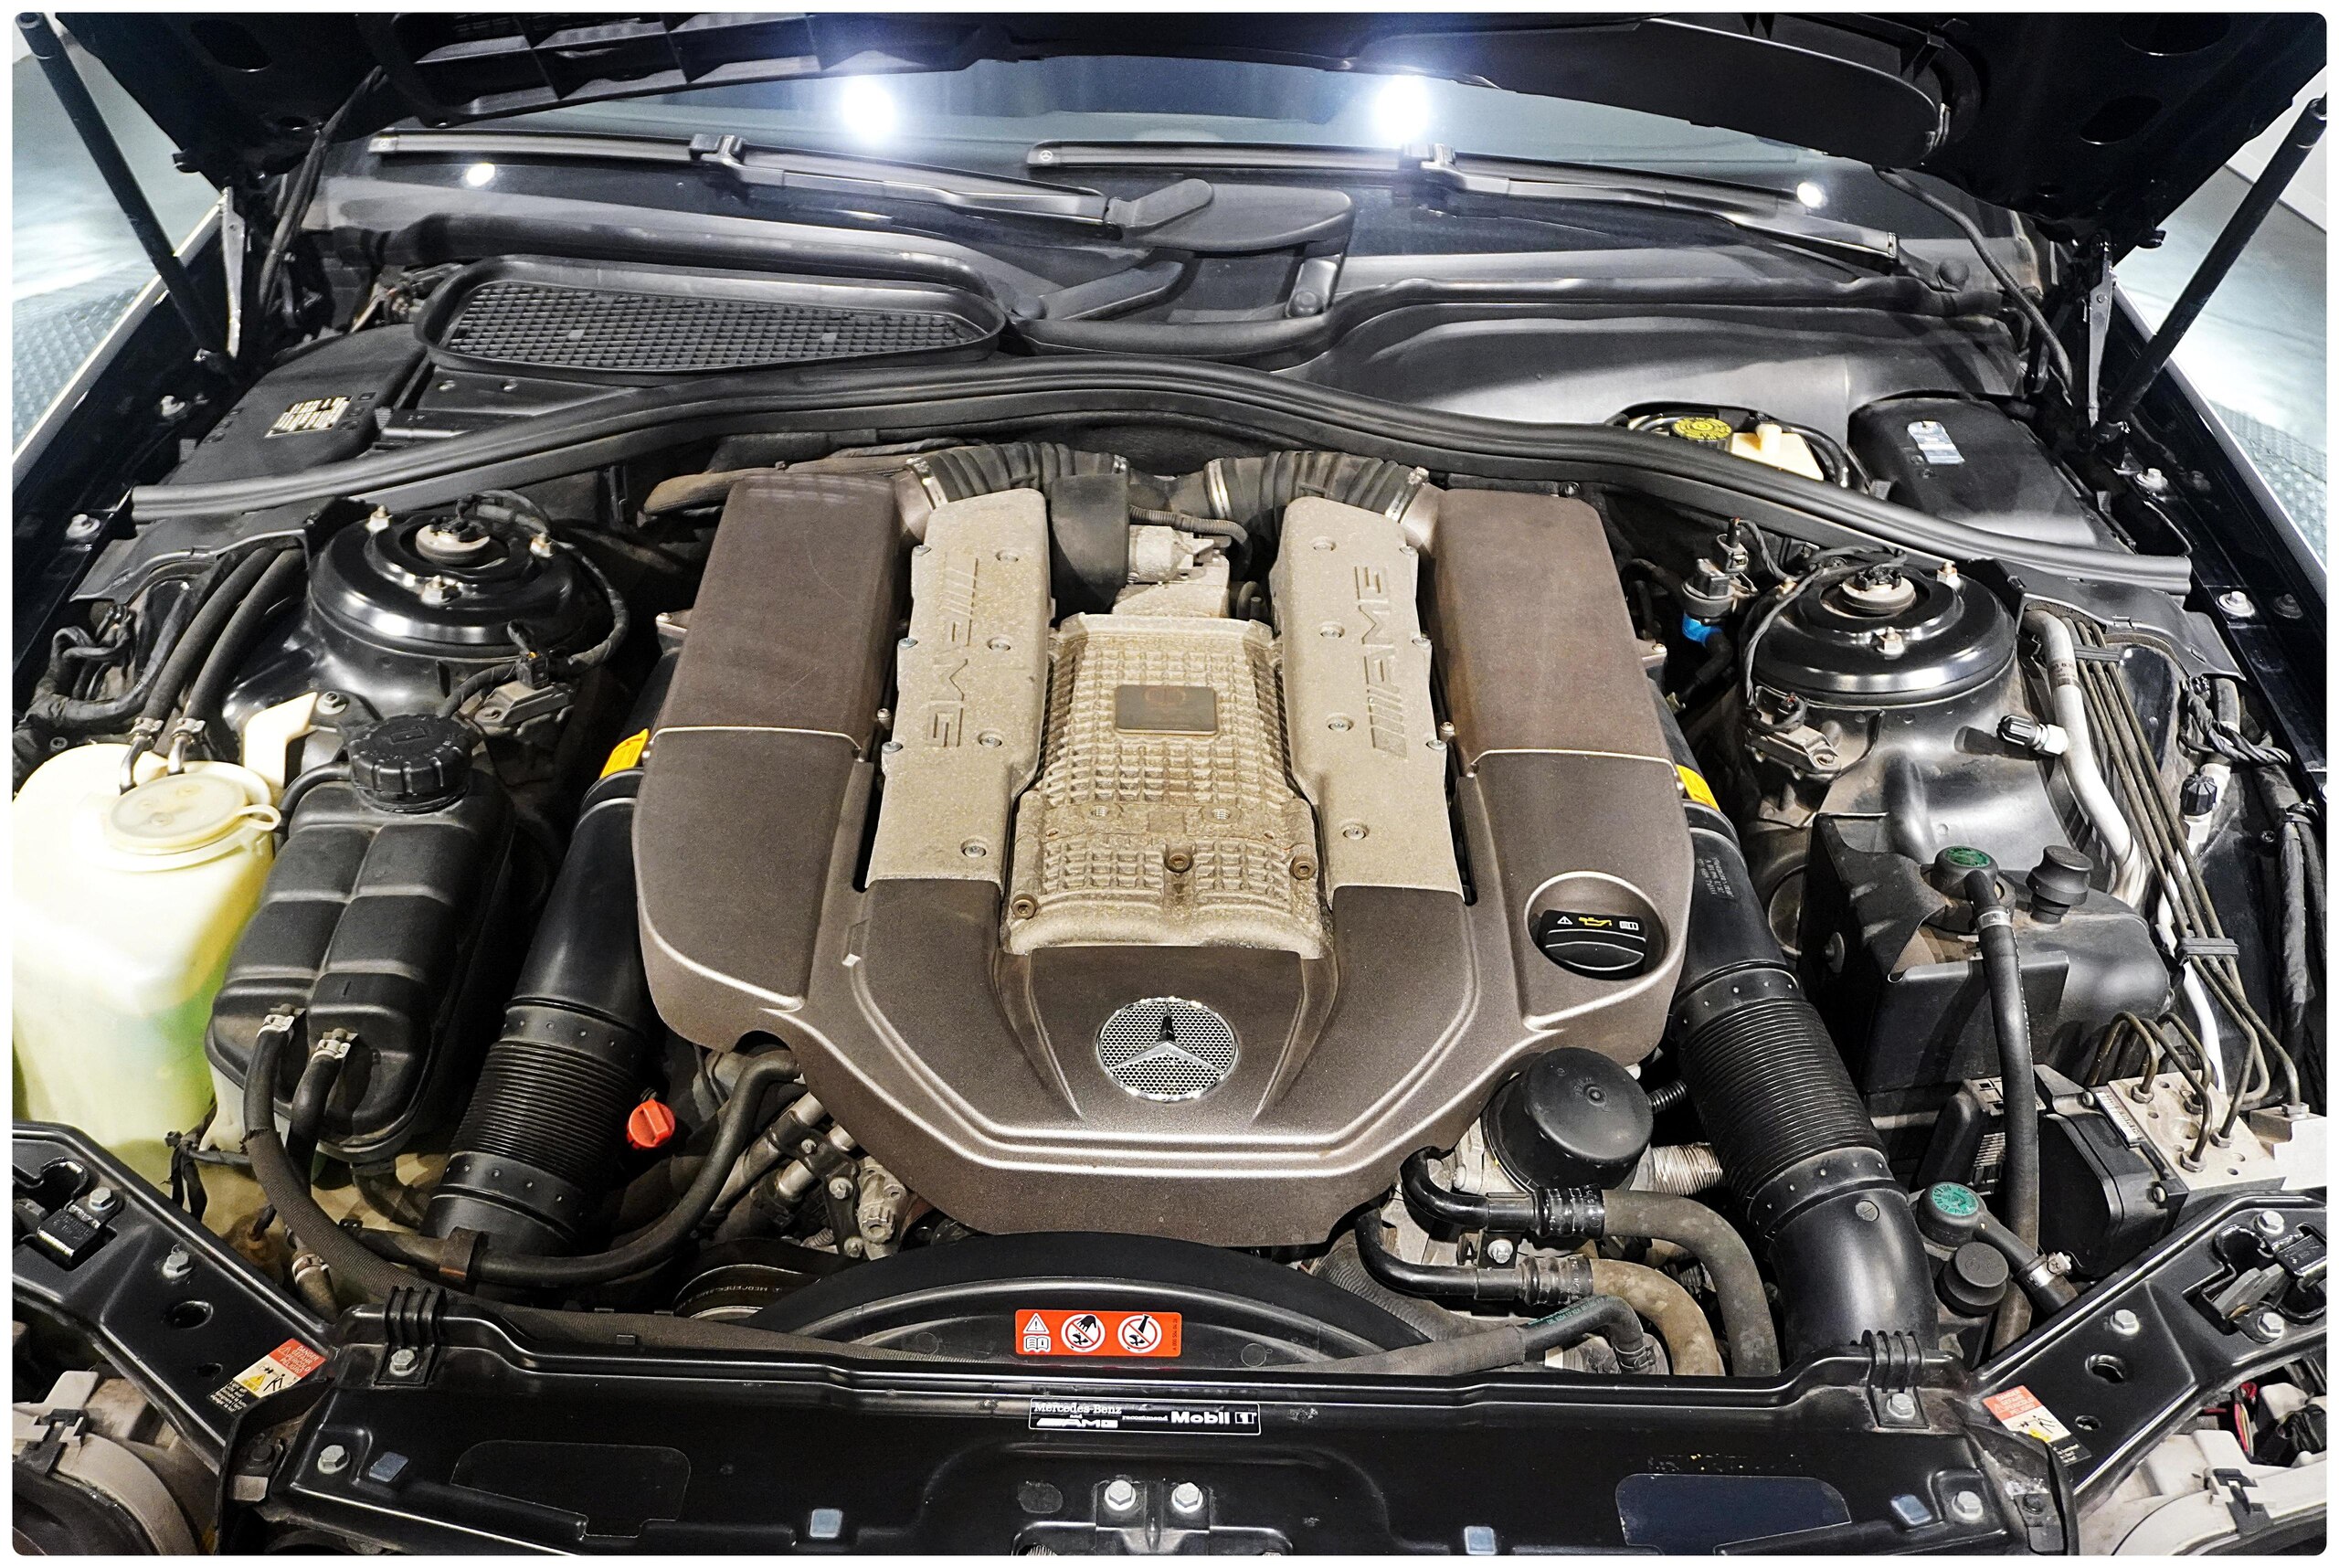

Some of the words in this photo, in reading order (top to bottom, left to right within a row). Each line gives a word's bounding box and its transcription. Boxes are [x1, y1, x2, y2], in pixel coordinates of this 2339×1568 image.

[1354, 565, 1404, 717] AMG
[925, 589, 975, 748] AMG
[296, 1345, 320, 1361] DANGER
[1033, 1402, 1122, 1414] Mercedes-Benz
[1047, 1418, 1118, 1429] AMG
[1170, 1411, 1231, 1425] Mobil
